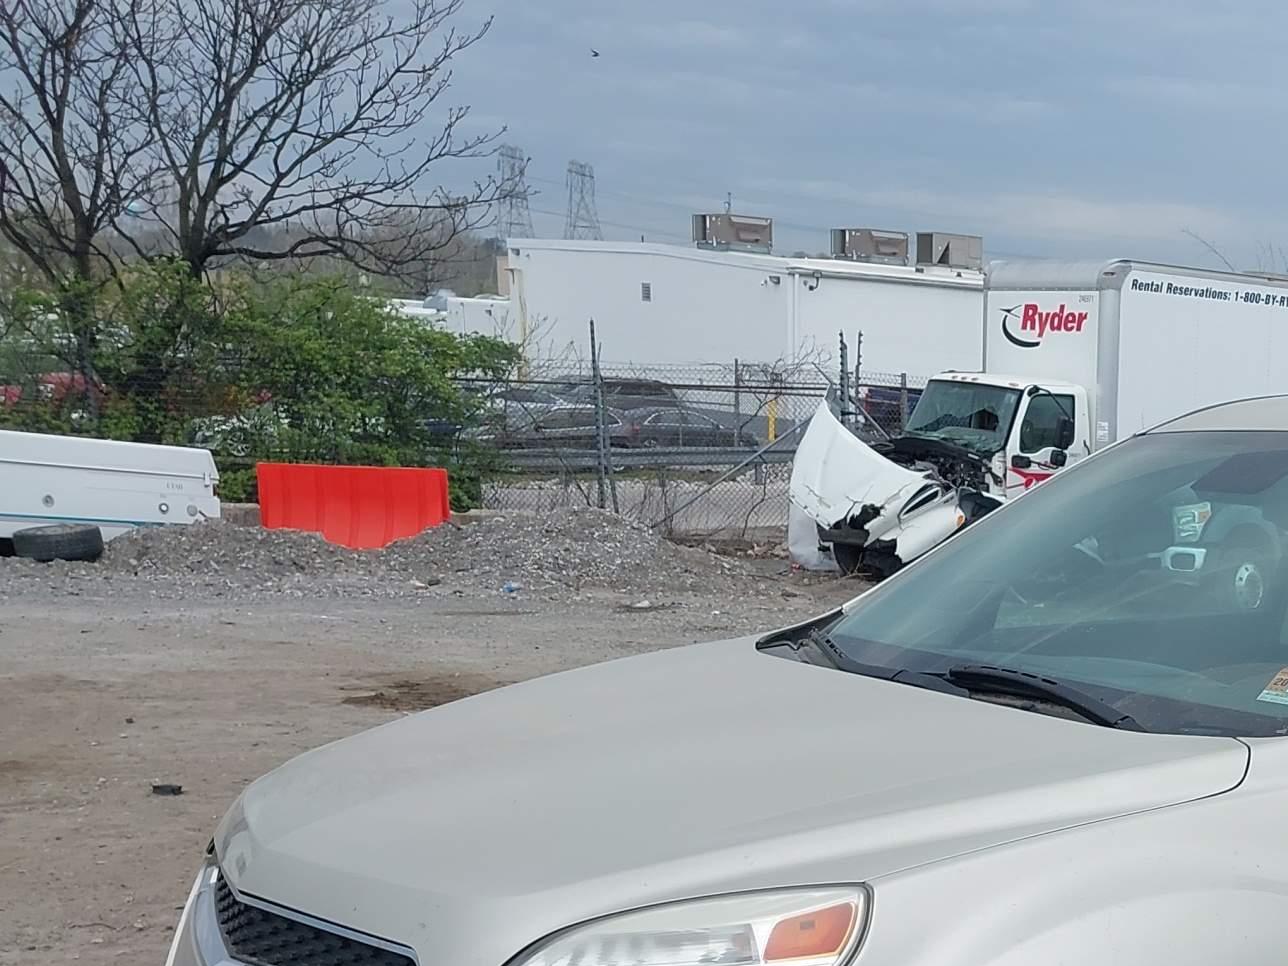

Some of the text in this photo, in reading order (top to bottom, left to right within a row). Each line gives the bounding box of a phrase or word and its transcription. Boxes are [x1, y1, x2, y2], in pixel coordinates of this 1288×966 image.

[1131, 278, 1164, 294] Rental
[1166, 283, 1231, 301] Reservations:
[1021, 303, 1088, 338] Ryder
